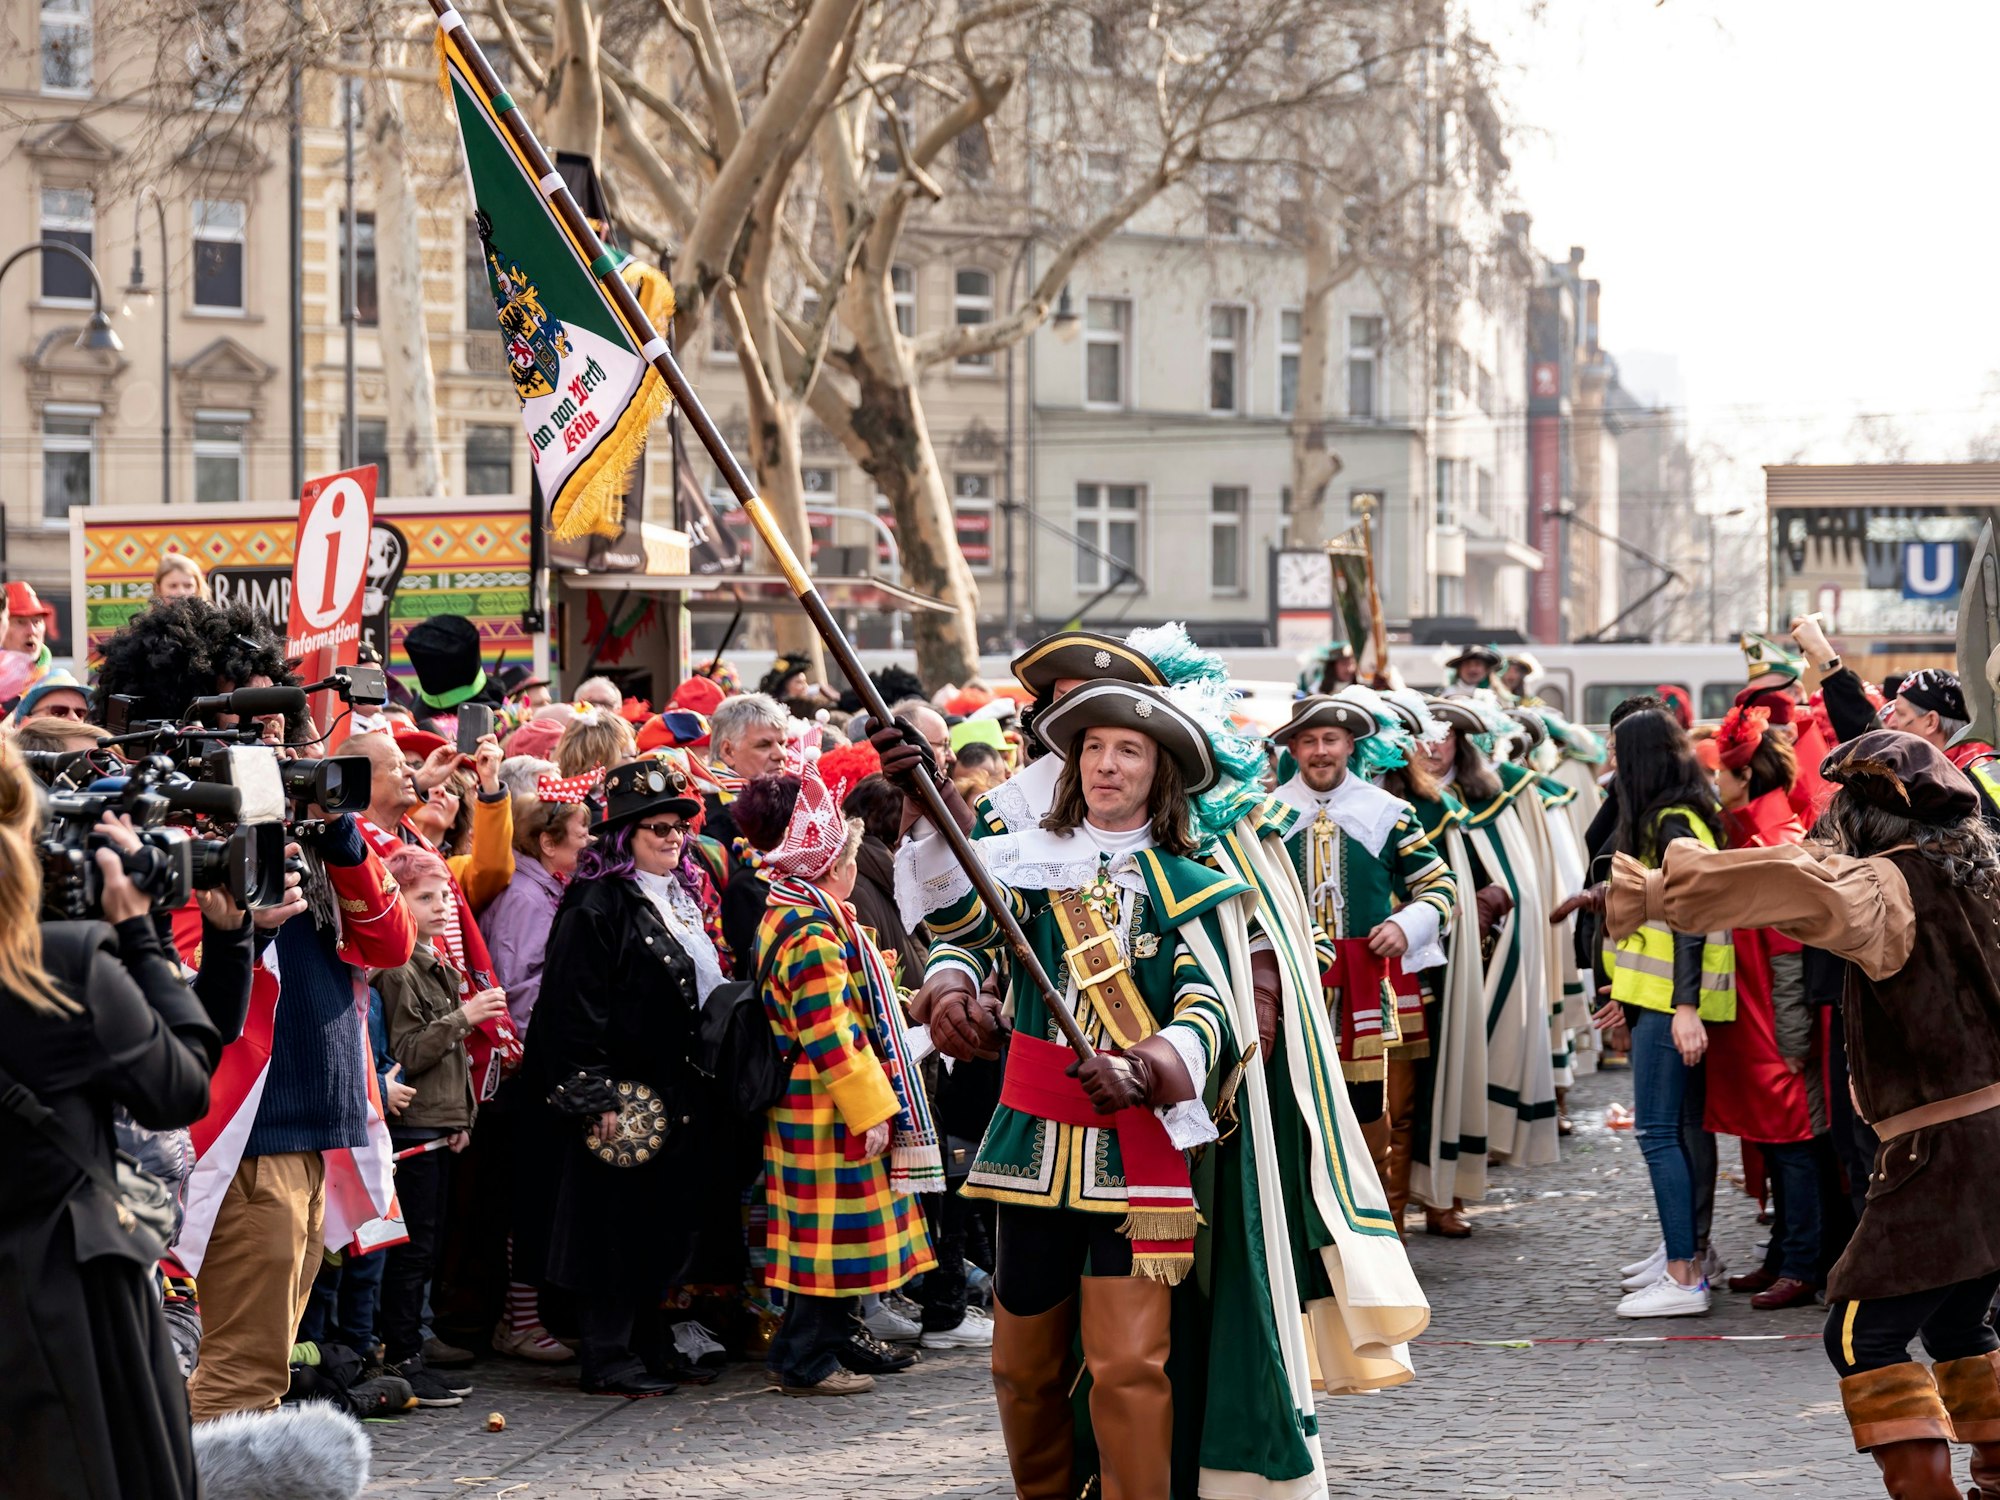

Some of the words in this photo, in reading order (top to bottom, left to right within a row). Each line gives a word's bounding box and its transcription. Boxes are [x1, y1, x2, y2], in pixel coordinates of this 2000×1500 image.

[550, 397, 578, 431] von
[567, 353, 608, 407] Werth
[563, 410, 600, 455] Köln
[1907, 543, 1954, 595] U
